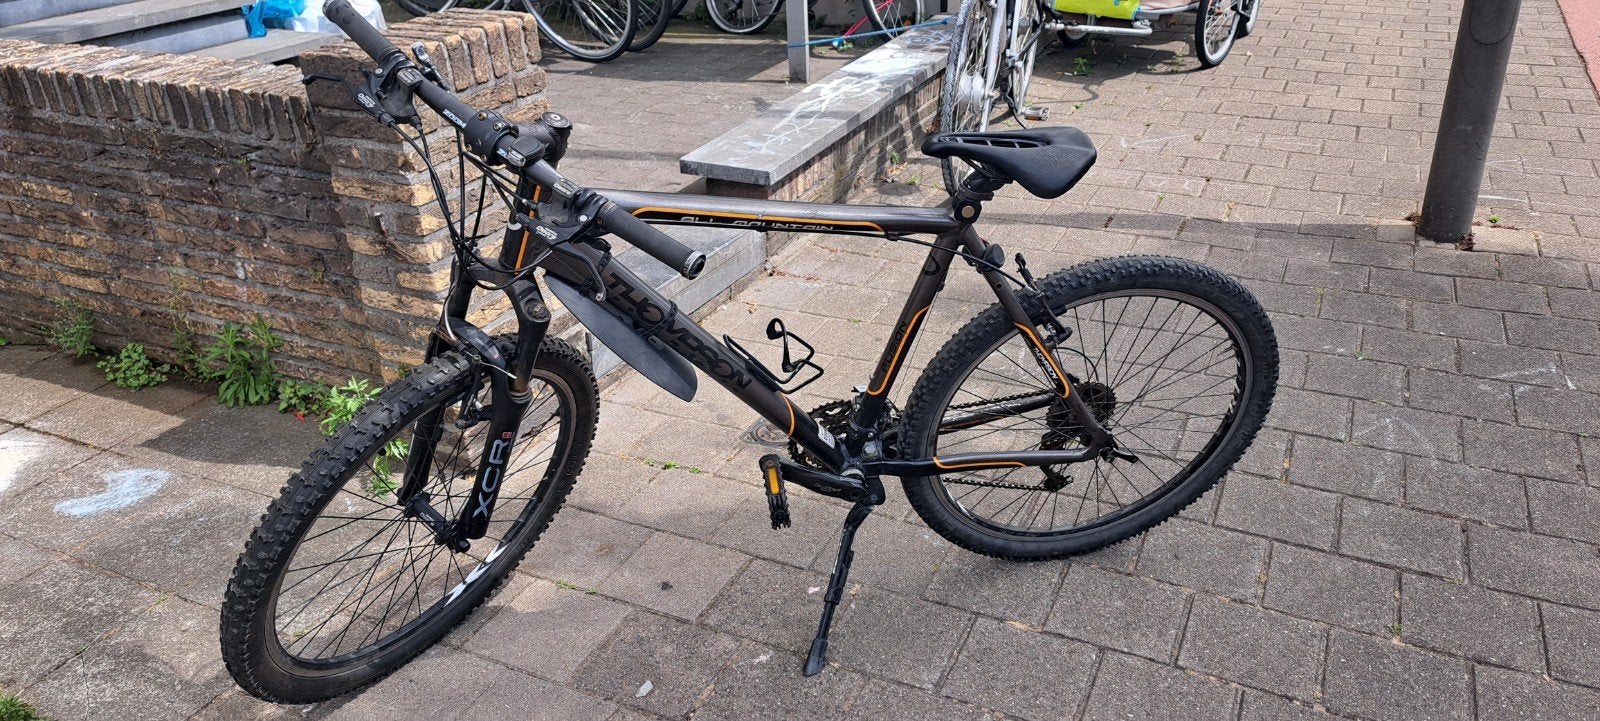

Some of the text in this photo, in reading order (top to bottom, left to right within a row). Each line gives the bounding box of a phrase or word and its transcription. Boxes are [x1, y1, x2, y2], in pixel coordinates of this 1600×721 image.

[442, 109, 468, 128] ZOOM
[732, 220, 834, 231] MOUNTAIN
[604, 271, 753, 390] THOMPSON
[881, 320, 908, 373] FUSION
[472, 439, 510, 519] XCR
